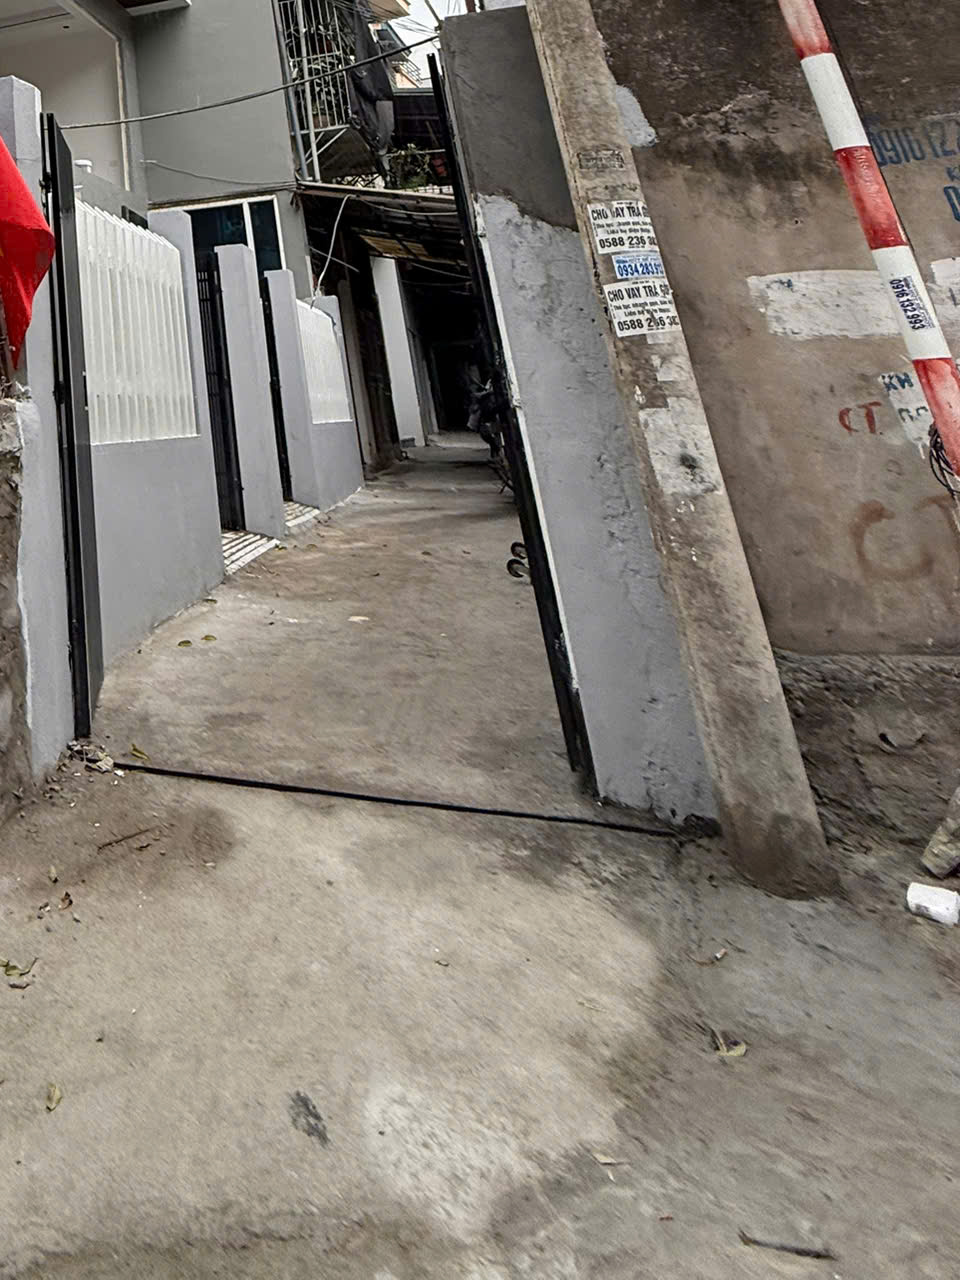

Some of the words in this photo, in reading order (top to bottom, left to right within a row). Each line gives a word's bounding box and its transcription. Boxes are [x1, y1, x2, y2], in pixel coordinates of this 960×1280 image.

[599, 237, 625, 249] 0588
[617, 263, 640, 277] 0934
[607, 288, 624, 302] CHO
[625, 286, 642, 299] VAY
[617, 318, 644, 332] 0588
